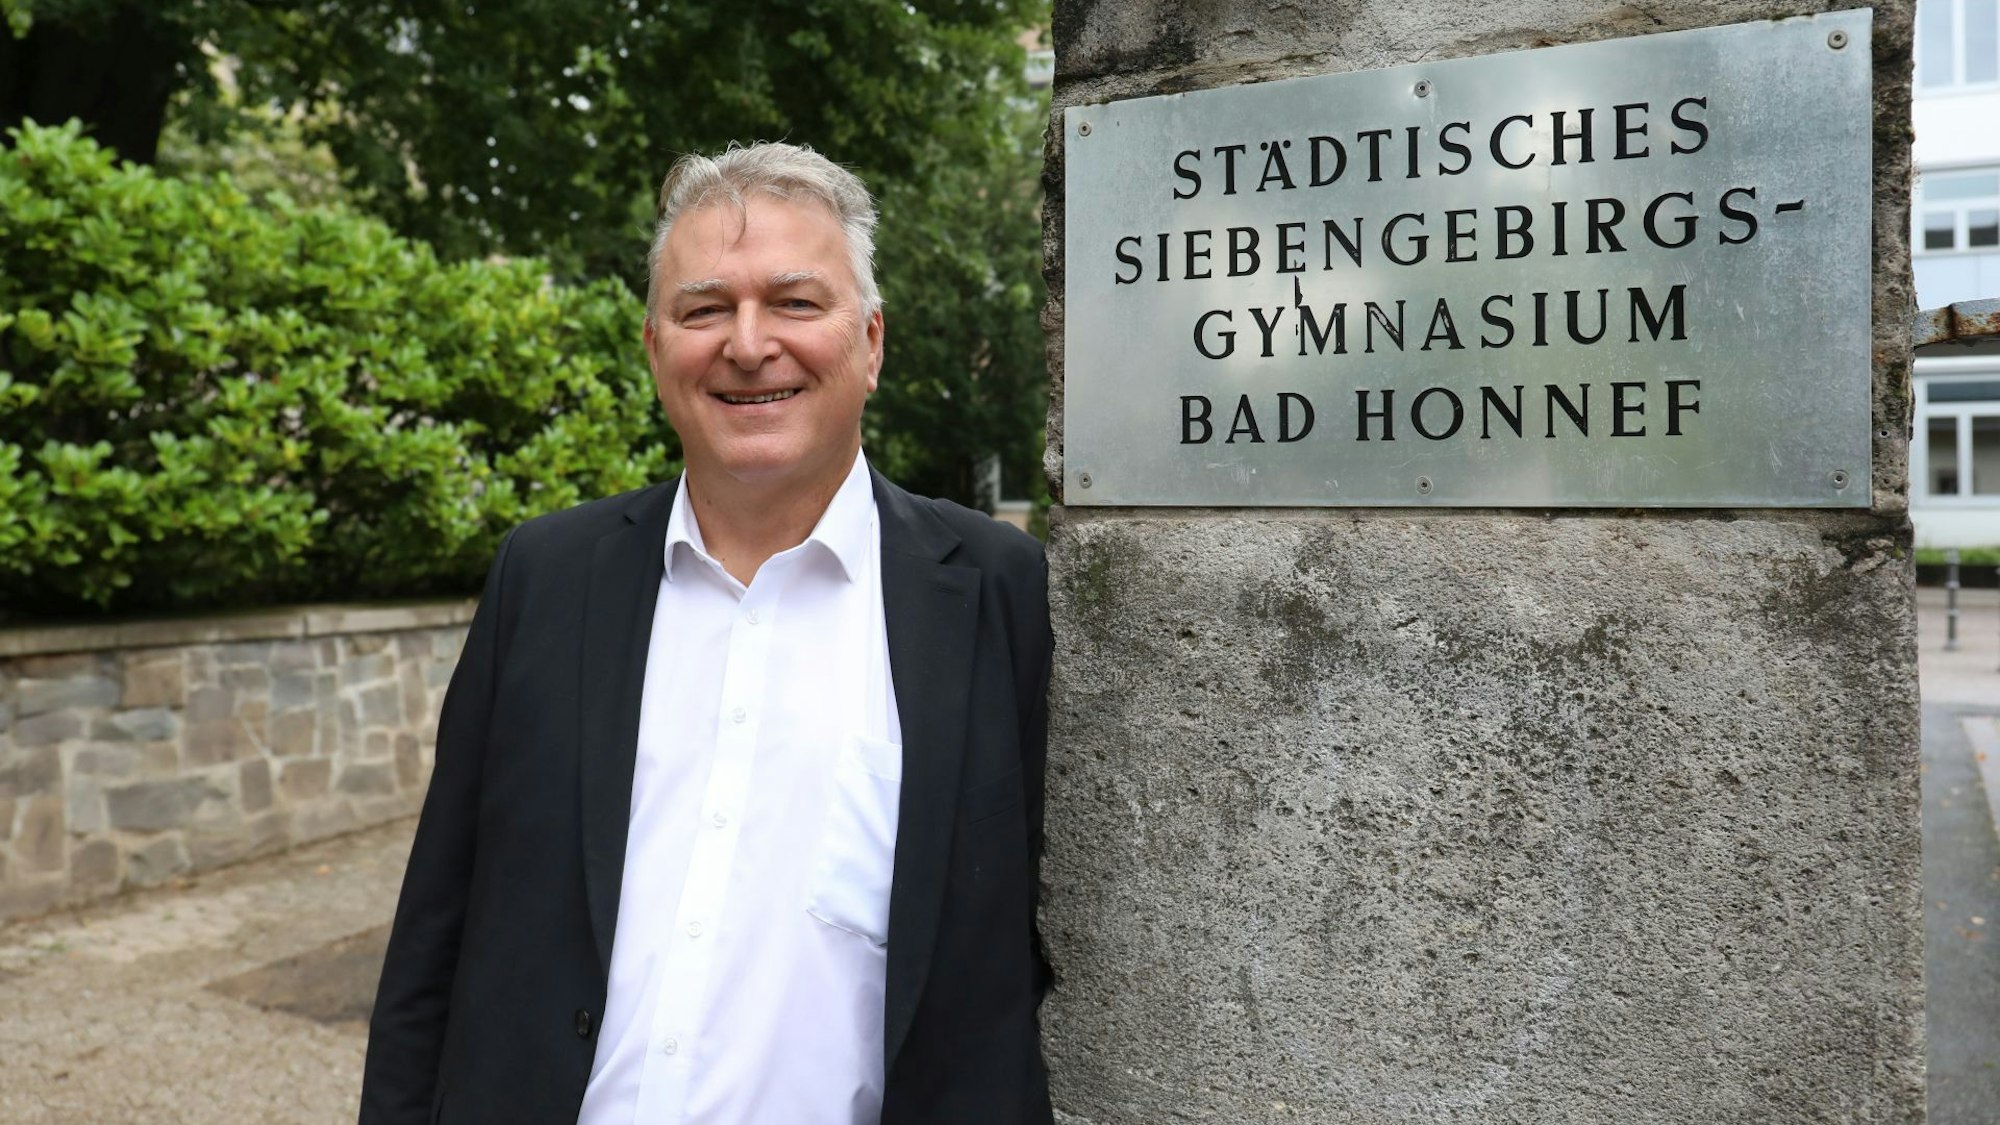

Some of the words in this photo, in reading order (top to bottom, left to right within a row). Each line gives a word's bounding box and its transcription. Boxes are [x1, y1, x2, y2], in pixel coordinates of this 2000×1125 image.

[1173, 96, 1710, 200] STÄDTISCHES
[1114, 186, 1806, 285] SIEBENGEBIRGS-
[1193, 284, 1689, 360] GYMNASIUM
[1179, 392, 1316, 445] BAD
[1355, 379, 1702, 443] HONNEF
